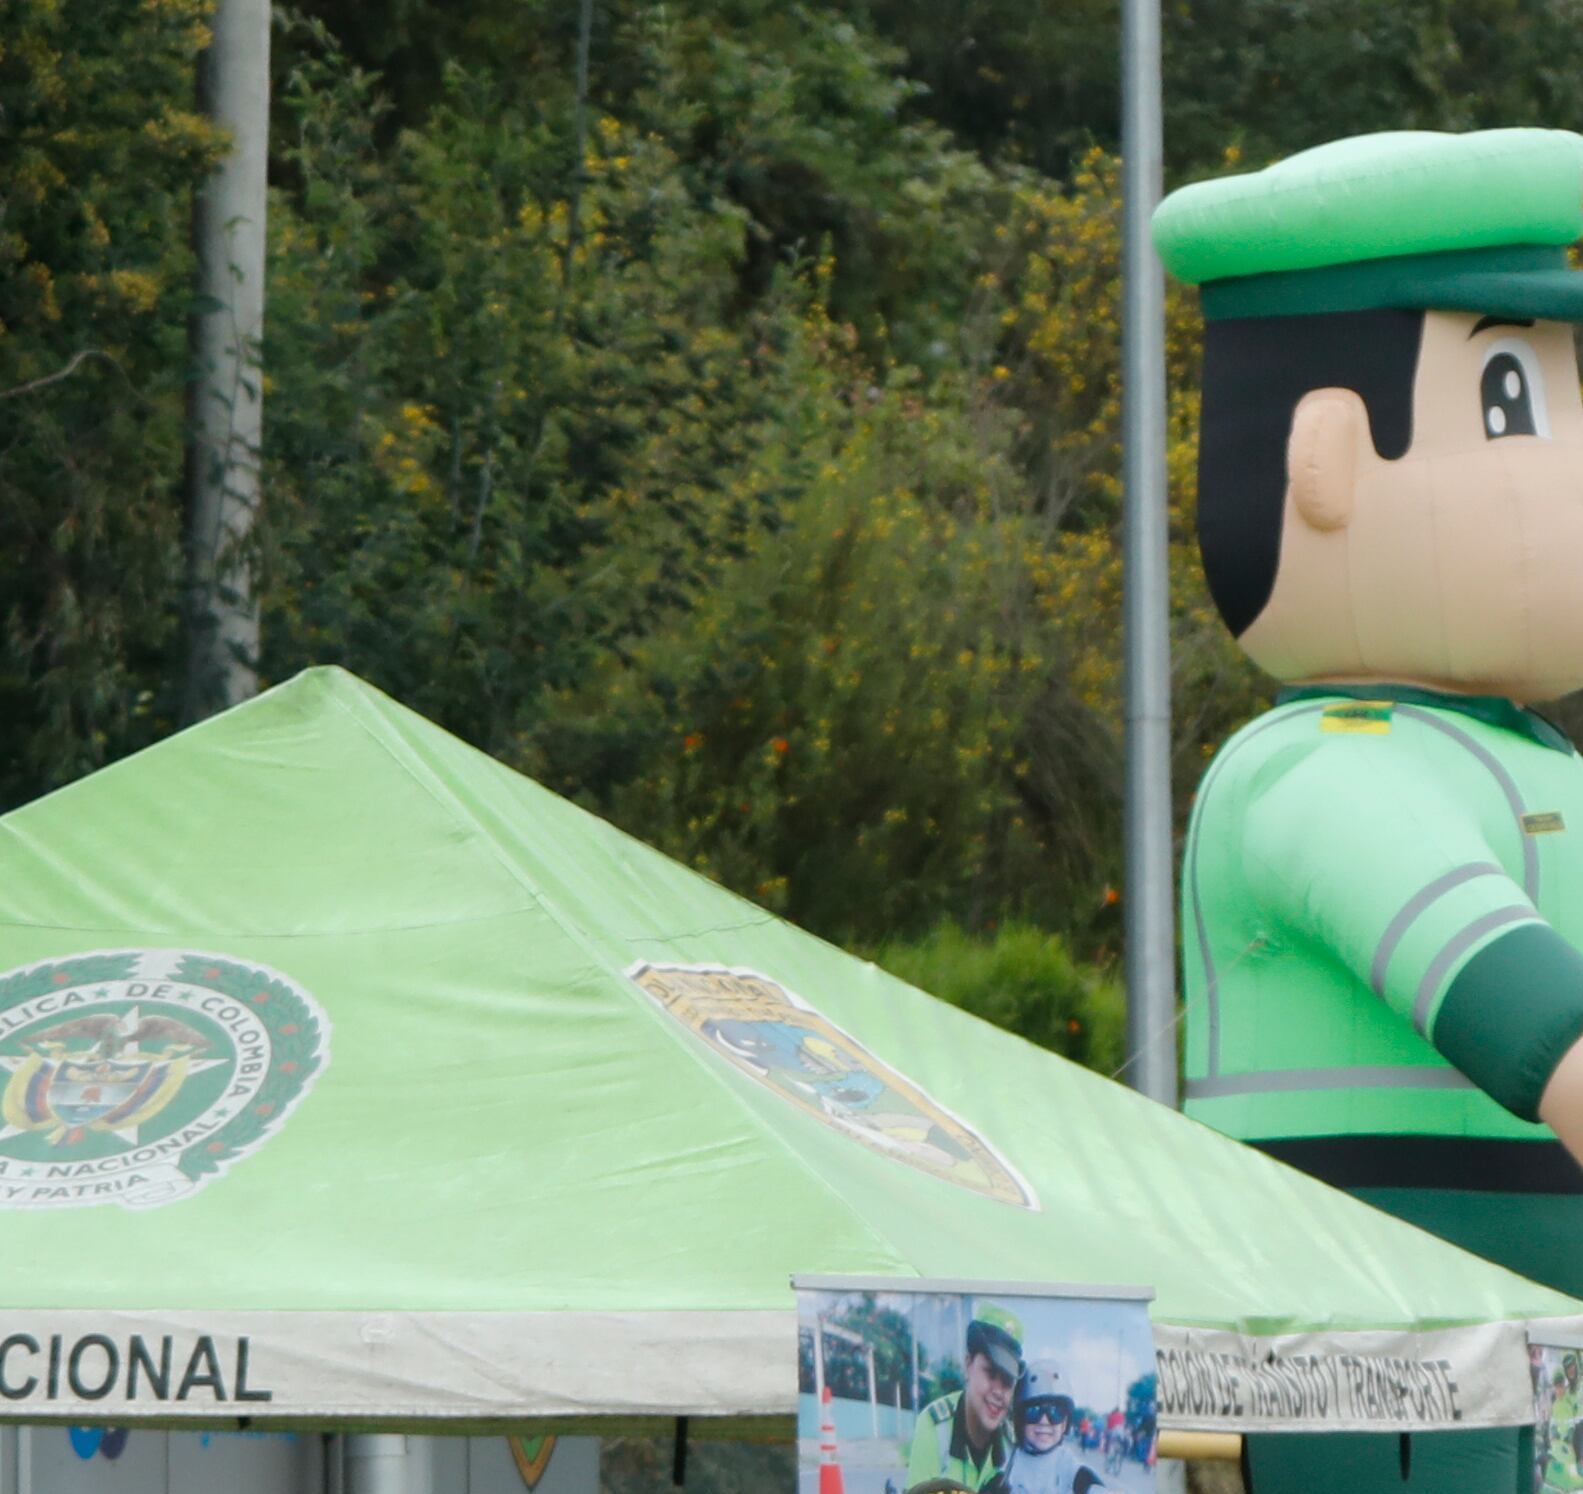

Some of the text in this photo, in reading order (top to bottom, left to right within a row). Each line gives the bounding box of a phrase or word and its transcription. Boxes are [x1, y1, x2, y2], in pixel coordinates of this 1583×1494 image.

[0, 983, 264, 1099] LICA DE COLOMBIA
[46, 1116, 222, 1178] NACIONAL
[31, 1173, 149, 1199] PATRIA
[0, 1332, 273, 1402] CIONAL
